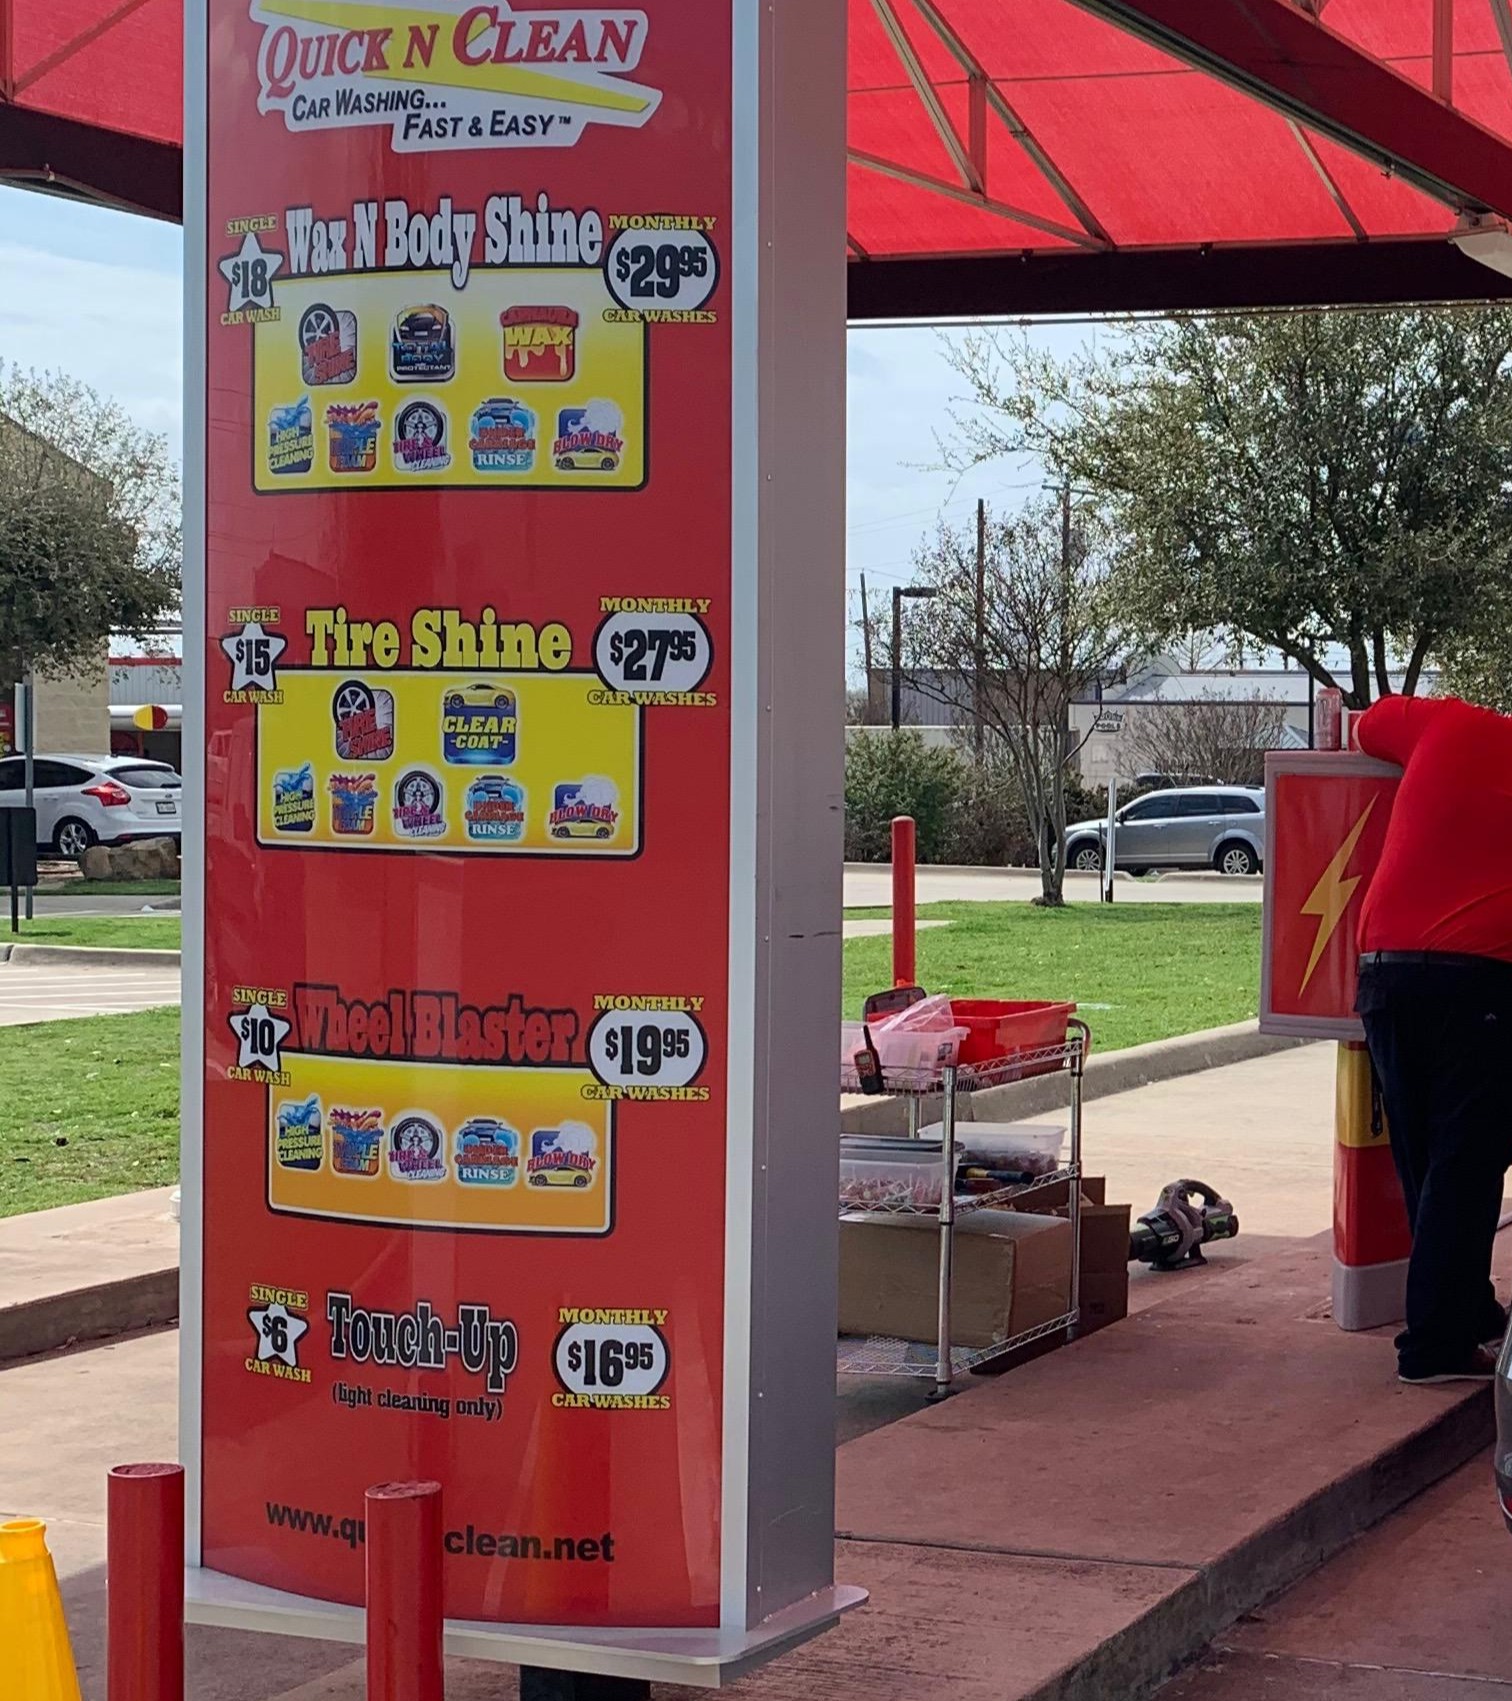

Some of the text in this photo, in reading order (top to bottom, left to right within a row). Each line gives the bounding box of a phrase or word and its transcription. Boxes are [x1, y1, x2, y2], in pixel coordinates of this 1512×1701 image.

[265, 6, 639, 99] QUICK N CLEAN
[293, 88, 447, 121] CAR WASHING...
[403, 112, 463, 139] FAST
[469, 117, 482, 137] &
[227, 216, 276, 235] SINGLE
[608, 215, 717, 230] MONTHLY
[286, 192, 603, 289] Wax N Body Shine
[232, 259, 267, 298] $18
[221, 308, 281, 325] CAR WASH
[603, 309, 717, 323] CAR WASHES
[504, 326, 573, 347] WAX
[553, 431, 624, 455] BLOW DRY
[270, 448, 314, 469] CLEANING
[477, 453, 526, 465] RINSE
[229, 607, 279, 623] SINGLE
[600, 597, 711, 614] MONTHLY
[306, 607, 572, 671] Tire Shine
[235, 638, 270, 676] $15
[223, 690, 284, 704] CAR WASH
[588, 691, 717, 706] CAR WASHES
[442, 716, 517, 734] CLEAR
[451, 735, 509, 749] -COAT-
[273, 799, 315, 817] PRESSURE
[550, 805, 619, 825] BLOW DRY
[274, 810, 315, 827] CLEANING
[472, 824, 515, 835] RINSE
[232, 987, 286, 1006] SINGLE
[594, 995, 705, 1011] MONTHLY
[294, 984, 579, 1063] Wheel Blaster
[241, 1017, 275, 1056] $10
[227, 1066, 291, 1086] CAR WASH
[581, 1085, 710, 1101] CAR WASHES
[285, 1125, 309, 1137] HIGH
[277, 1135, 322, 1148] PRESSURE
[278, 1147, 323, 1162] CLEANING
[527, 1151, 596, 1173] BLOW DRY
[462, 1168, 510, 1180] RINSE
[251, 1285, 308, 1309] SINGLE
[559, 1307, 668, 1325] MONTHLY
[262, 1314, 288, 1353] $6
[326, 1292, 518, 1393] Touch-Up
[245, 1358, 312, 1383] CAR WASH
[332, 1383, 503, 1421] (light cleaning only)
[551, 1393, 671, 1409] CAR WASHES
